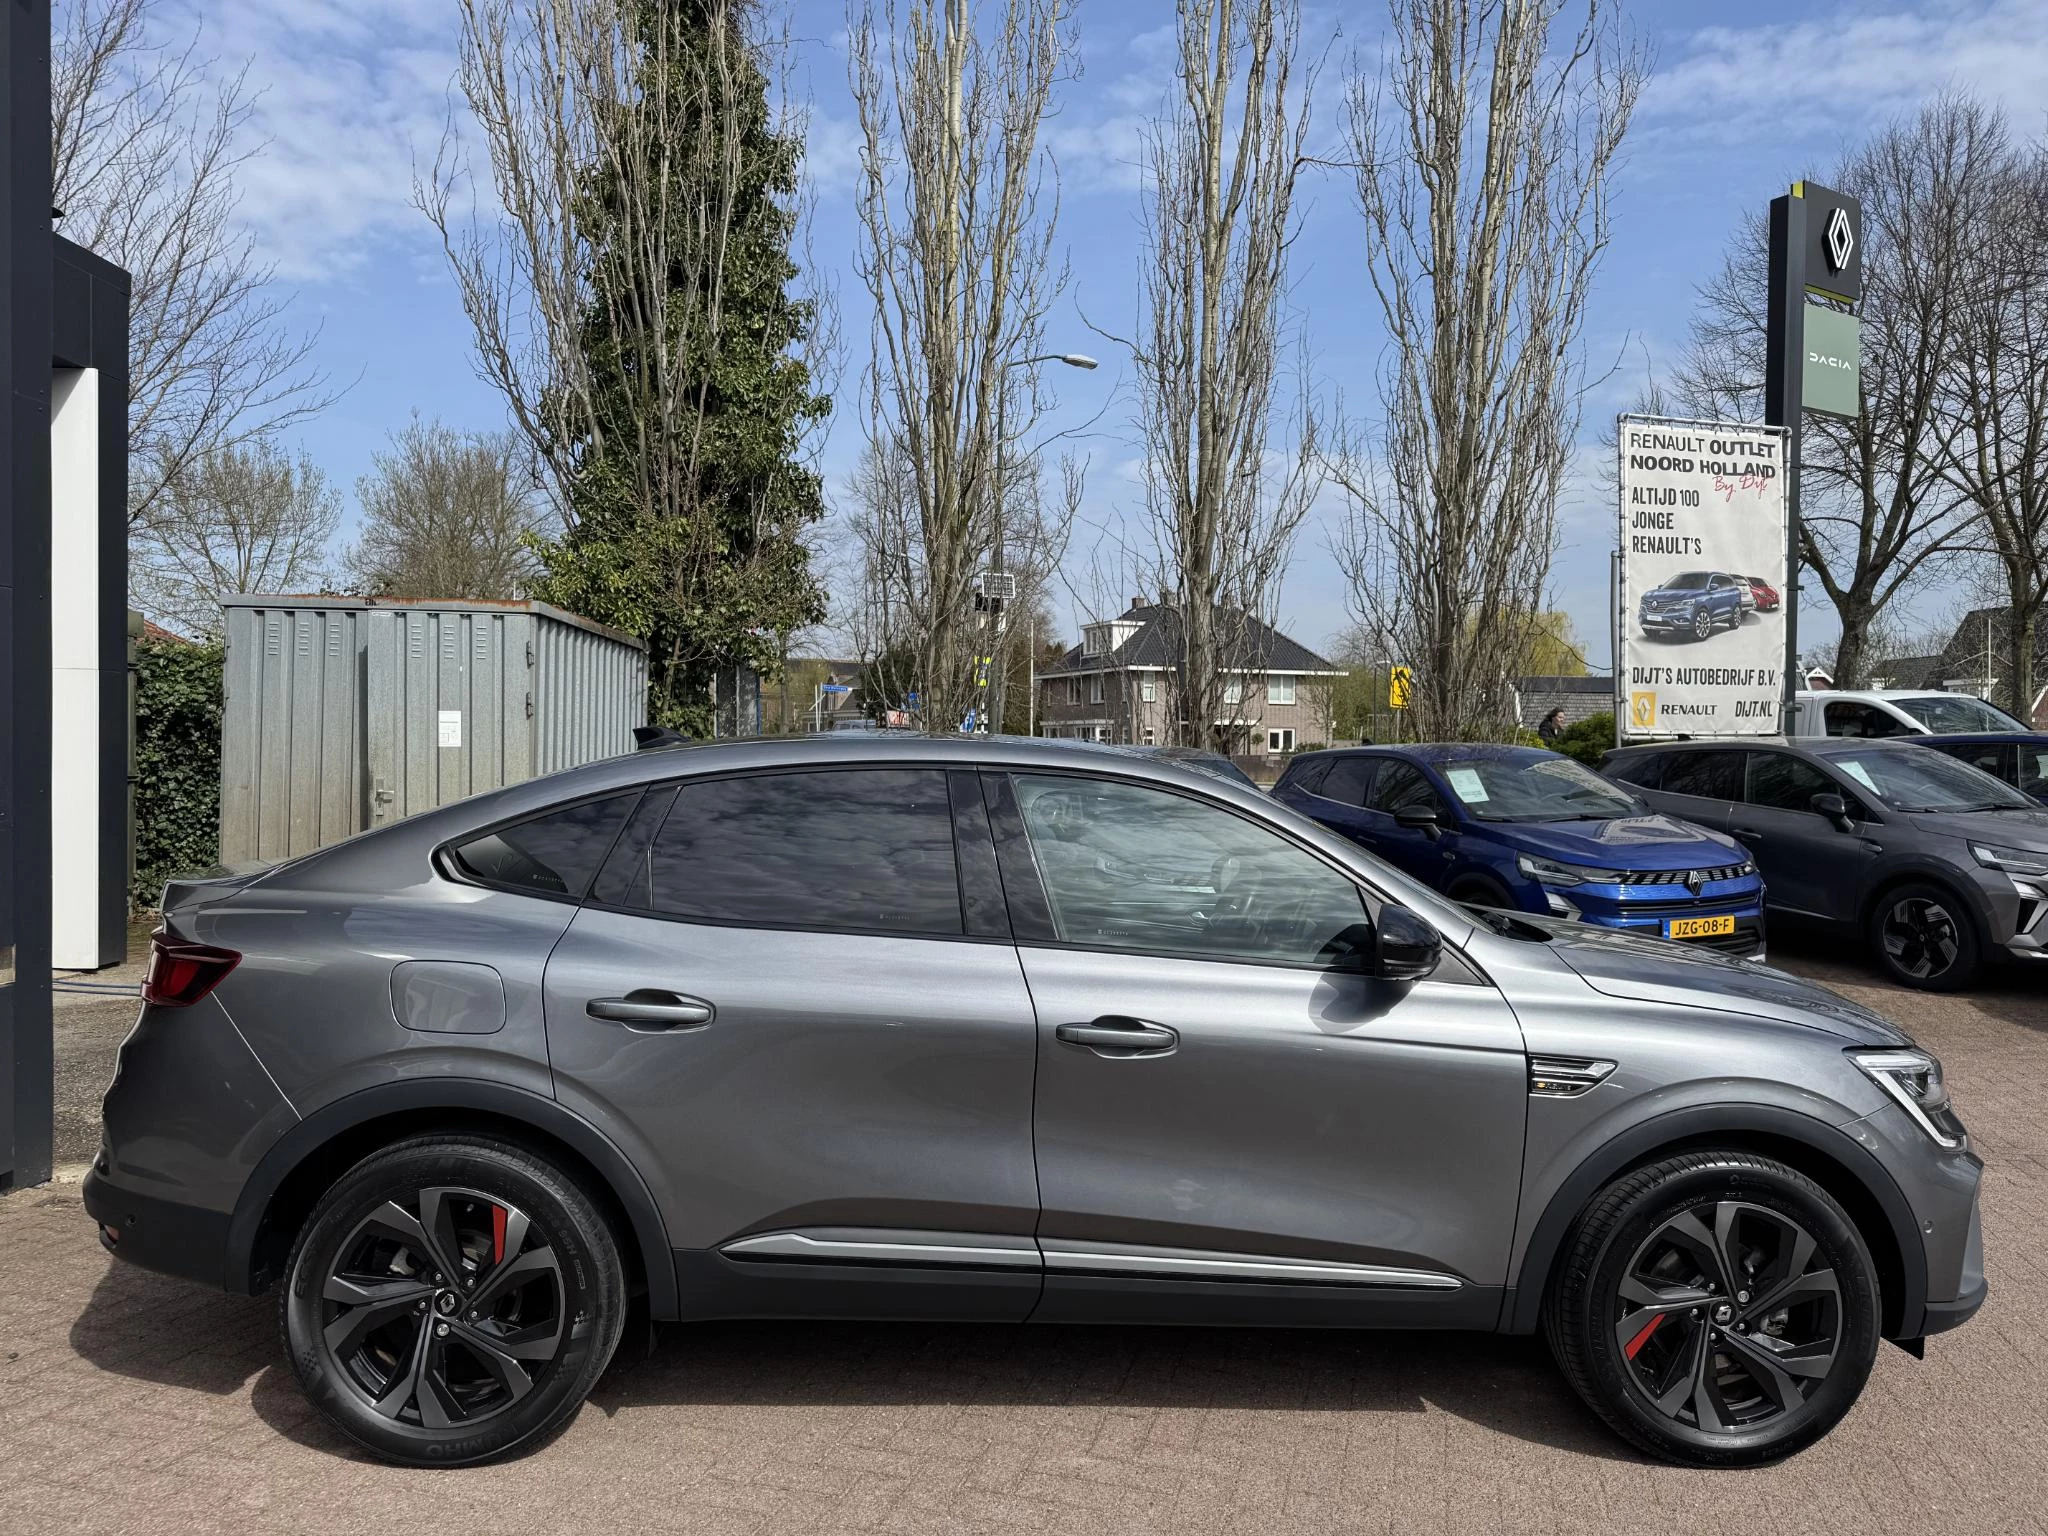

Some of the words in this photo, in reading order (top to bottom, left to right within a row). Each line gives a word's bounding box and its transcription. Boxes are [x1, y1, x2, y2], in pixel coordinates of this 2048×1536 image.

[1809, 351, 1852, 371] DACIA
[1630, 432, 1705, 453] RENAULT
[1709, 439, 1776, 458] OUTLET
[1630, 454, 1695, 473] NOORD
[1699, 460, 1776, 478] HOLLAND
[1631, 486, 1677, 506] ALTIJD
[1679, 489, 1700, 507] 100
[1712, 475, 1736, 502] By
[1631, 511, 1674, 530] JONGE
[1632, 535, 1702, 555] RENAULT'S
[1632, 666, 1673, 685] DIJT'S
[1676, 667, 1755, 686] AUTOBEDRIJF
[1757, 670, 1776, 687] B.V.
[1660, 703, 1718, 716] RENAULT
[1735, 700, 1773, 718] DIJT.NL
[1675, 918, 1730, 935] JZG-08-F
